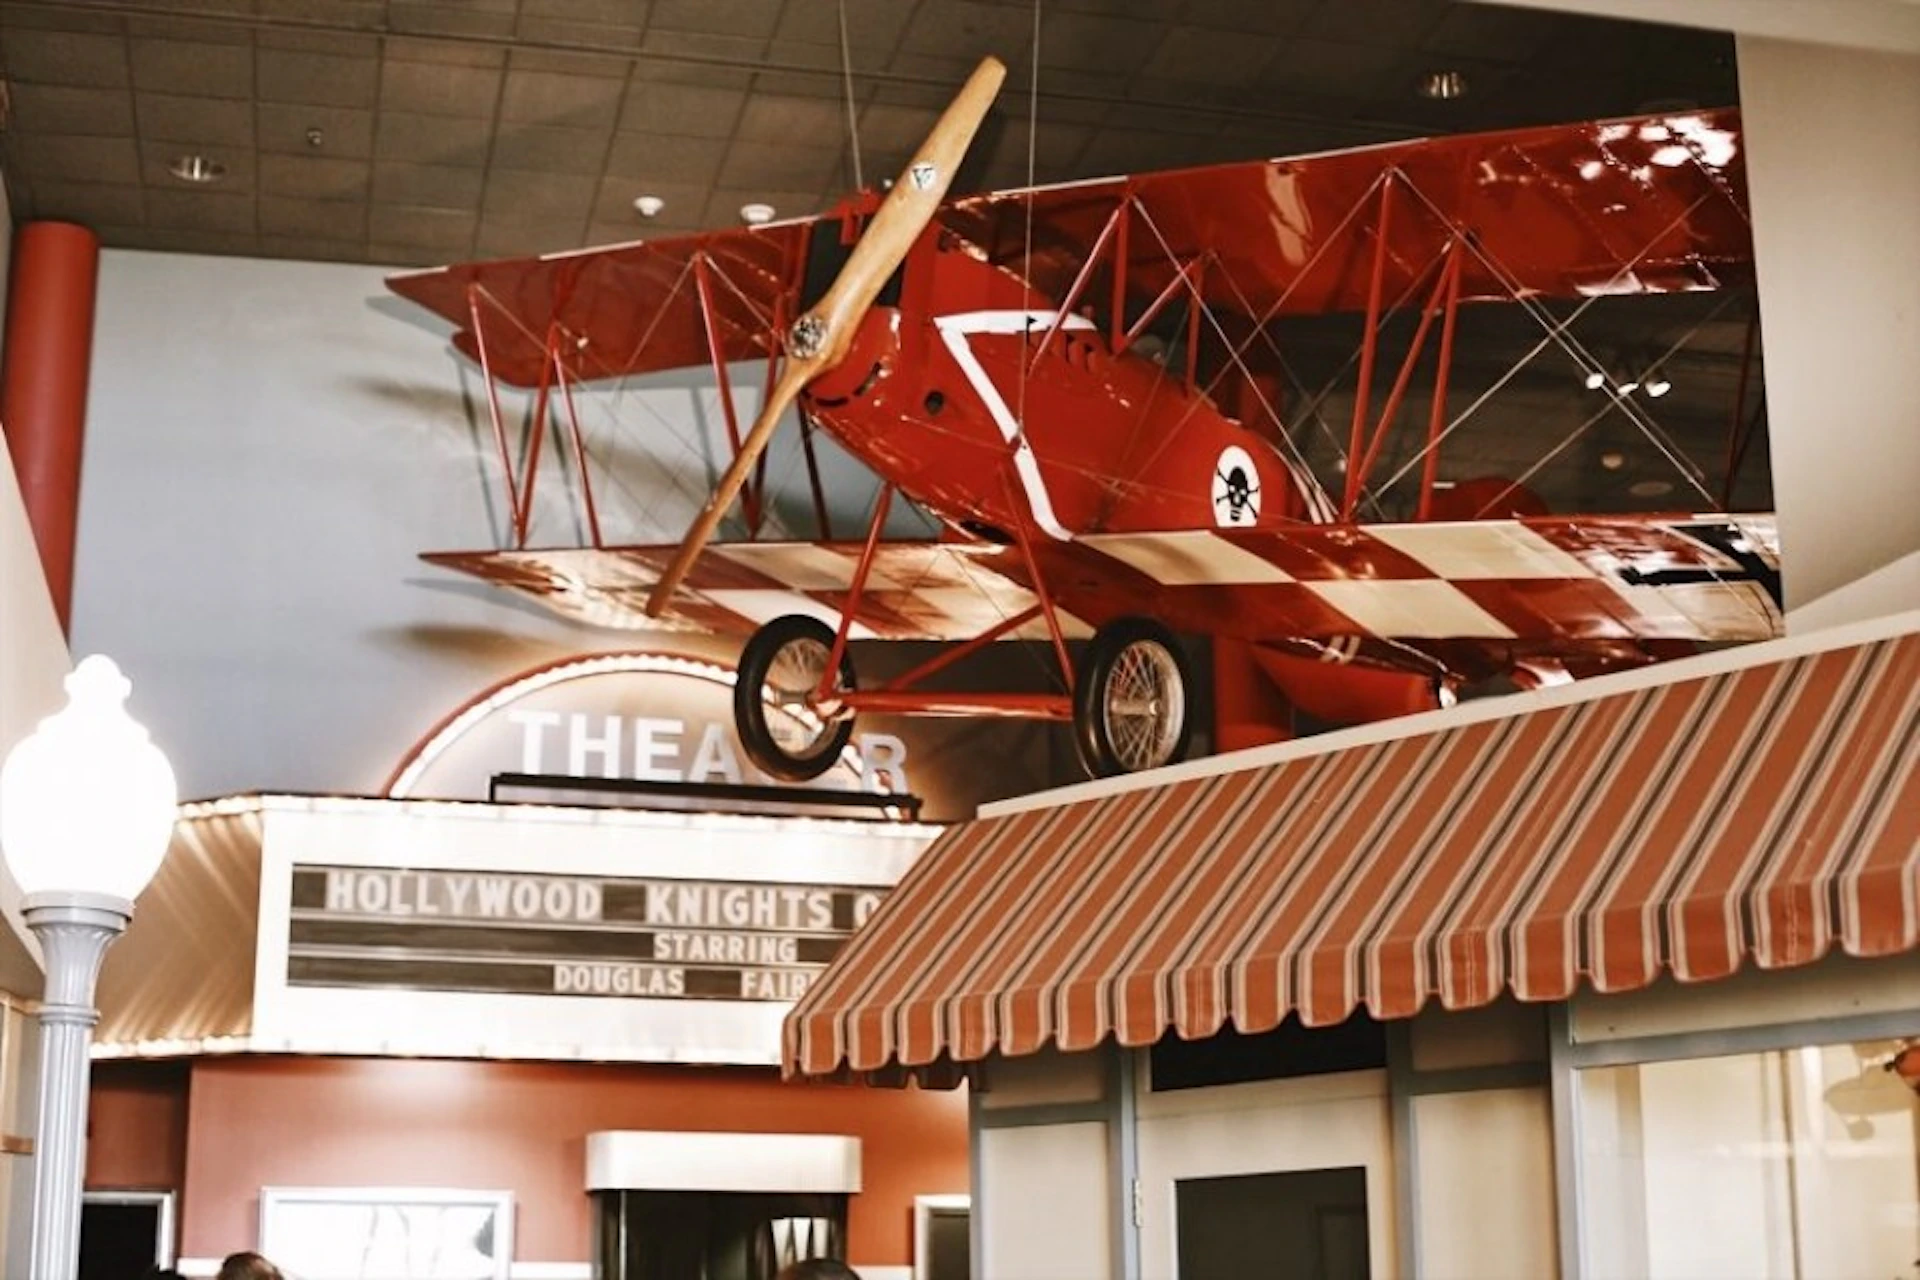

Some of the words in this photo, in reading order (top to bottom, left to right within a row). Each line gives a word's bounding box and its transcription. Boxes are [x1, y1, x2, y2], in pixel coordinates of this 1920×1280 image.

[508, 709, 908, 795] THEAR
[327, 870, 602, 920] HOLLYWOOD
[645, 884, 833, 928] KNIGHTS
[653, 933, 798, 962] STARRING
[554, 964, 685, 995] DOUGLAS
[741, 970, 818, 998] FAIR
